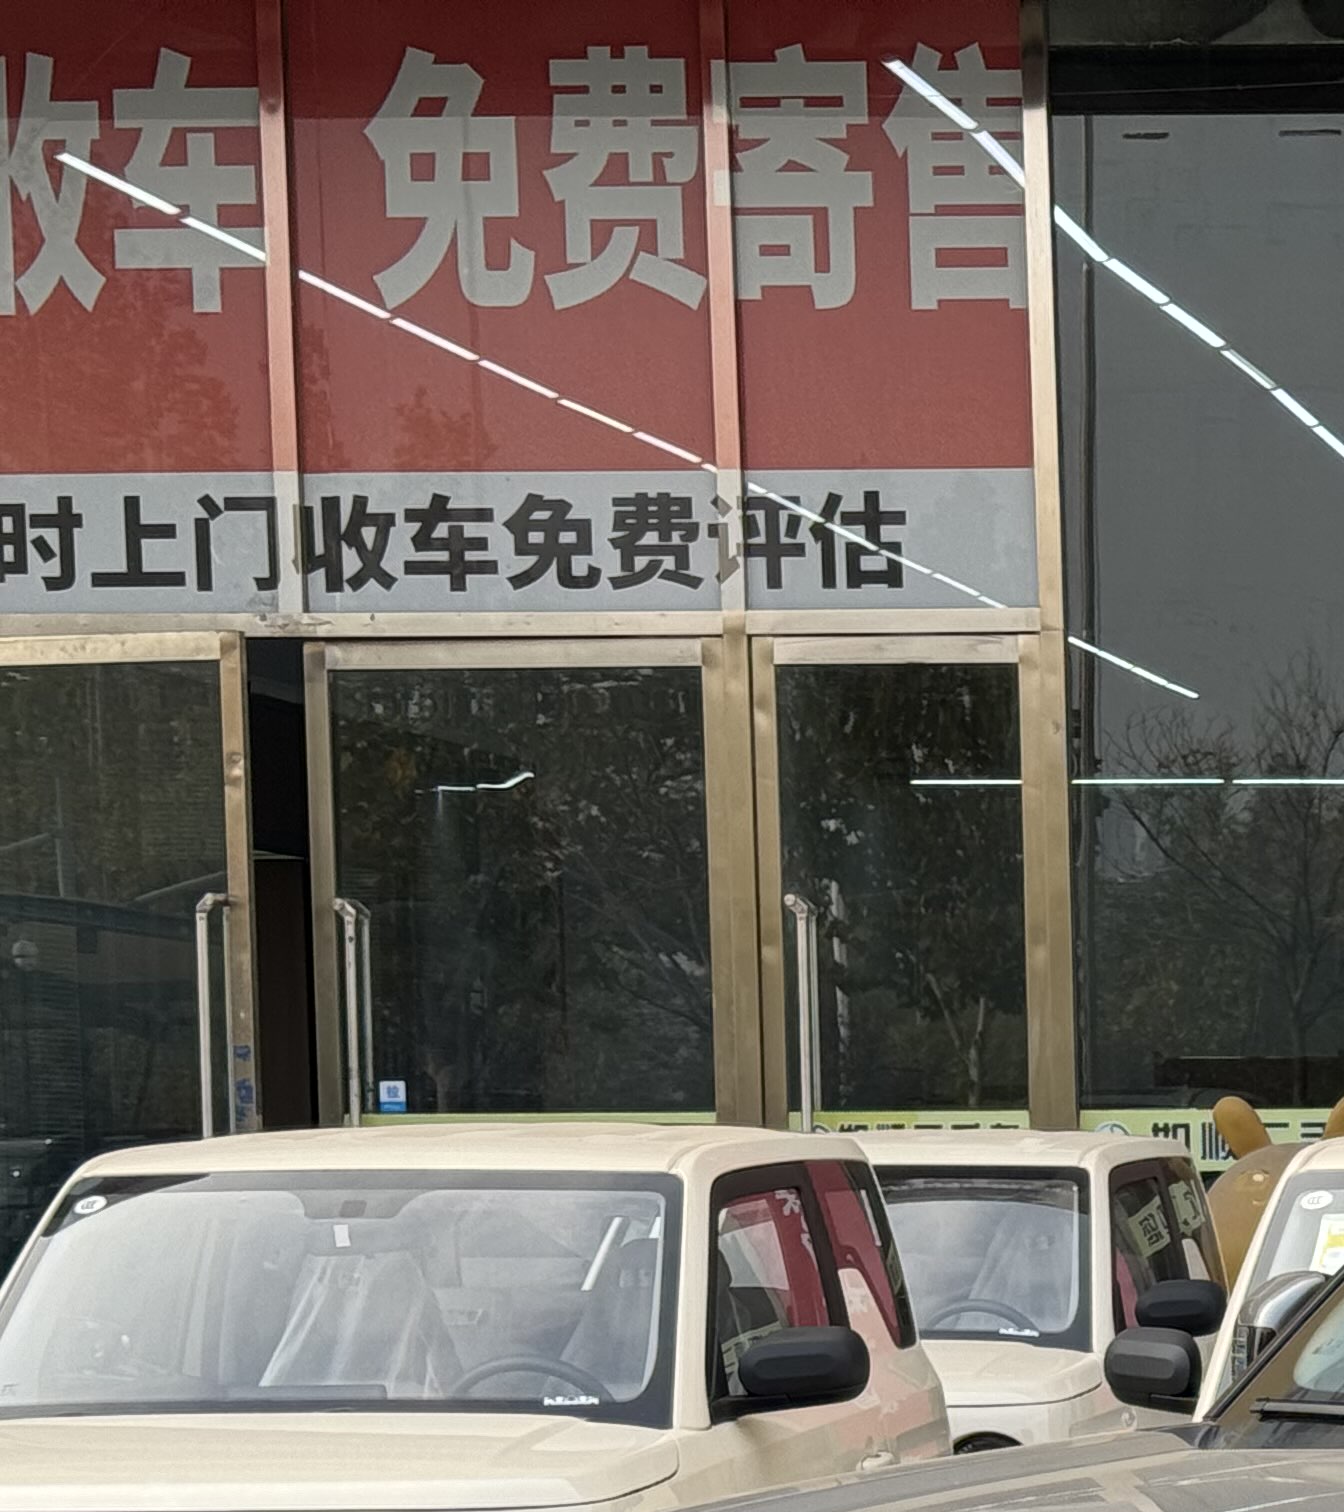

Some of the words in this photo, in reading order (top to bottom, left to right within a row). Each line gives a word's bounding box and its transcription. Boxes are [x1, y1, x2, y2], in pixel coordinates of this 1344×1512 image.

[365, 44, 1027, 310] 免费寄售
[0, 490, 907, 594] 时上门收车免费评估
